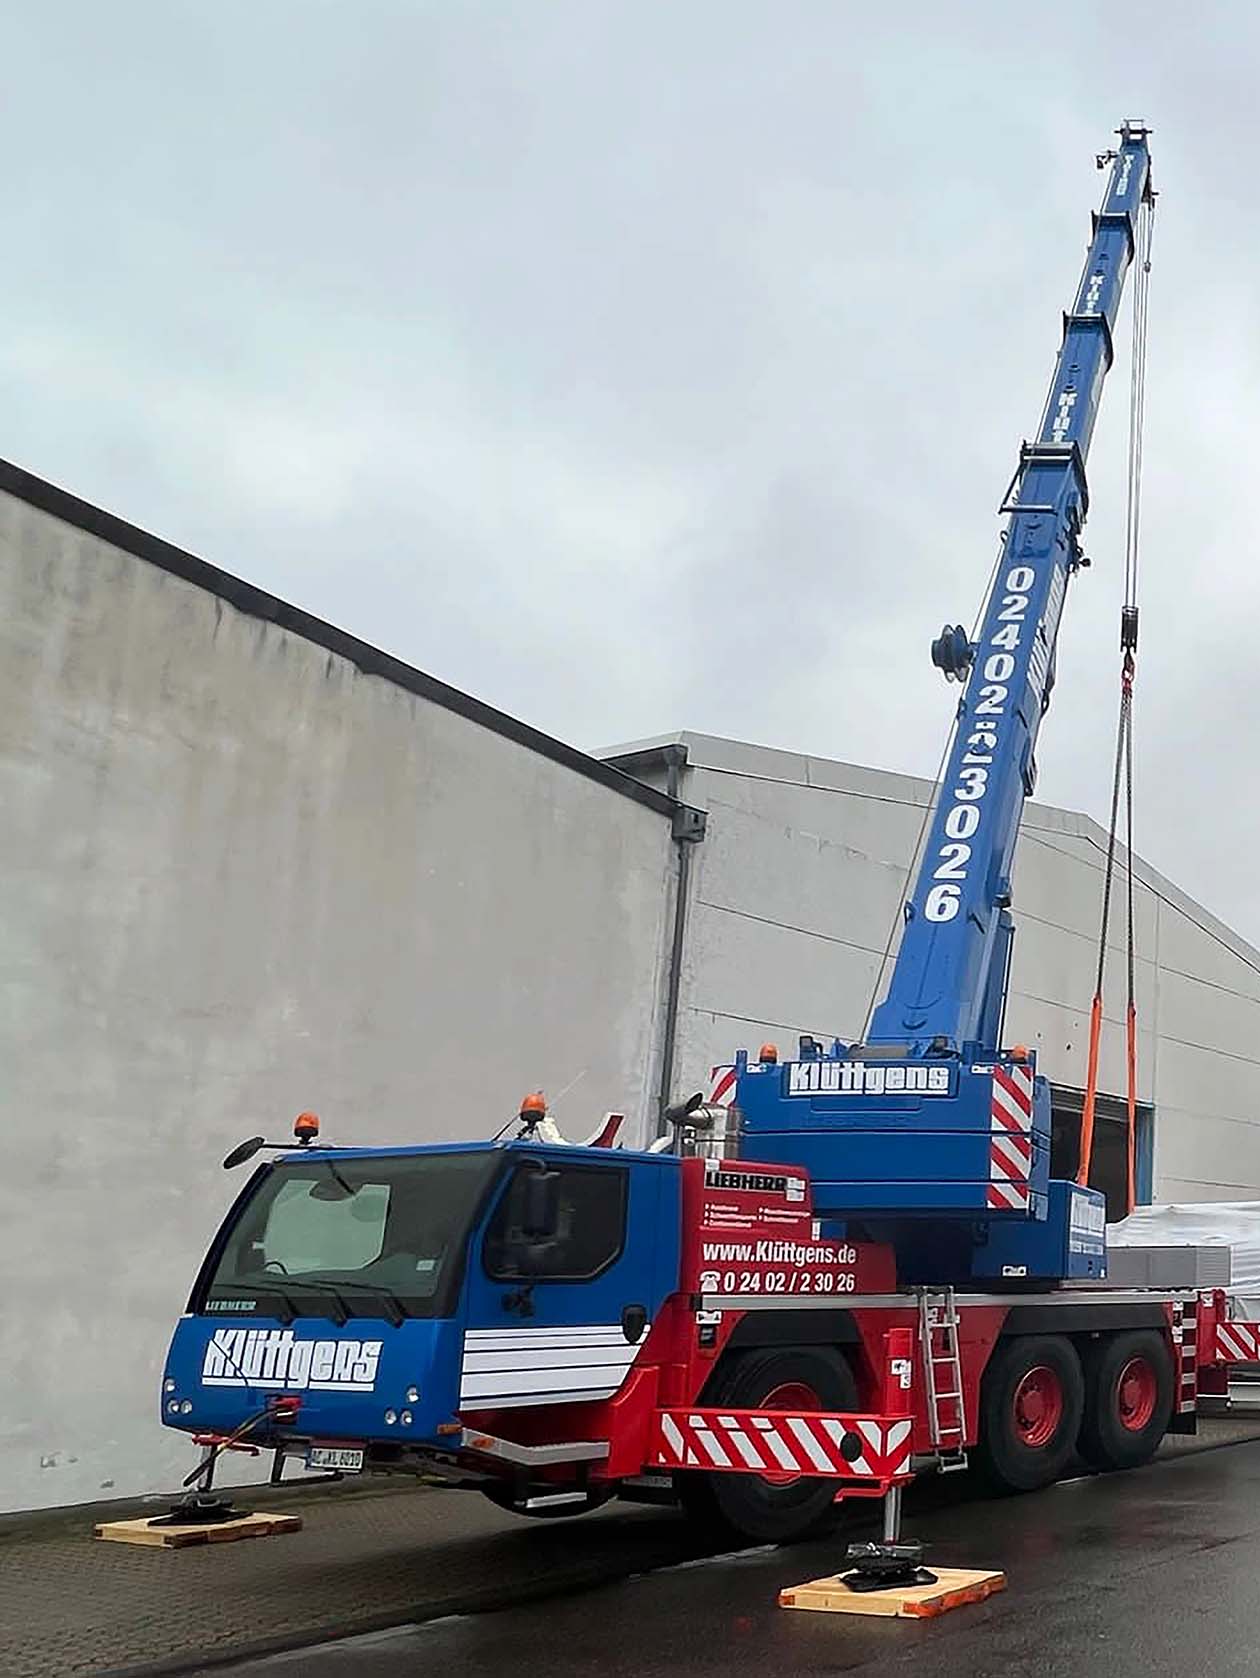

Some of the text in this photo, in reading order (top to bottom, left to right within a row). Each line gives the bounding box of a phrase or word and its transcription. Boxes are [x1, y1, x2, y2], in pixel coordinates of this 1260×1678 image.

[790, 1062, 949, 1094] Klüttgens
[703, 1241, 857, 1268] www.Klüttgens.de
[724, 1272, 735, 1292] 0
[740, 1272, 761, 1292] 24
[765, 1272, 786, 1292] 02
[801, 1273, 811, 1292] 2
[814, 1273, 833, 1292] 30
[837, 1273, 855, 1292] 26
[203, 1329, 384, 1390] Klüttgens
